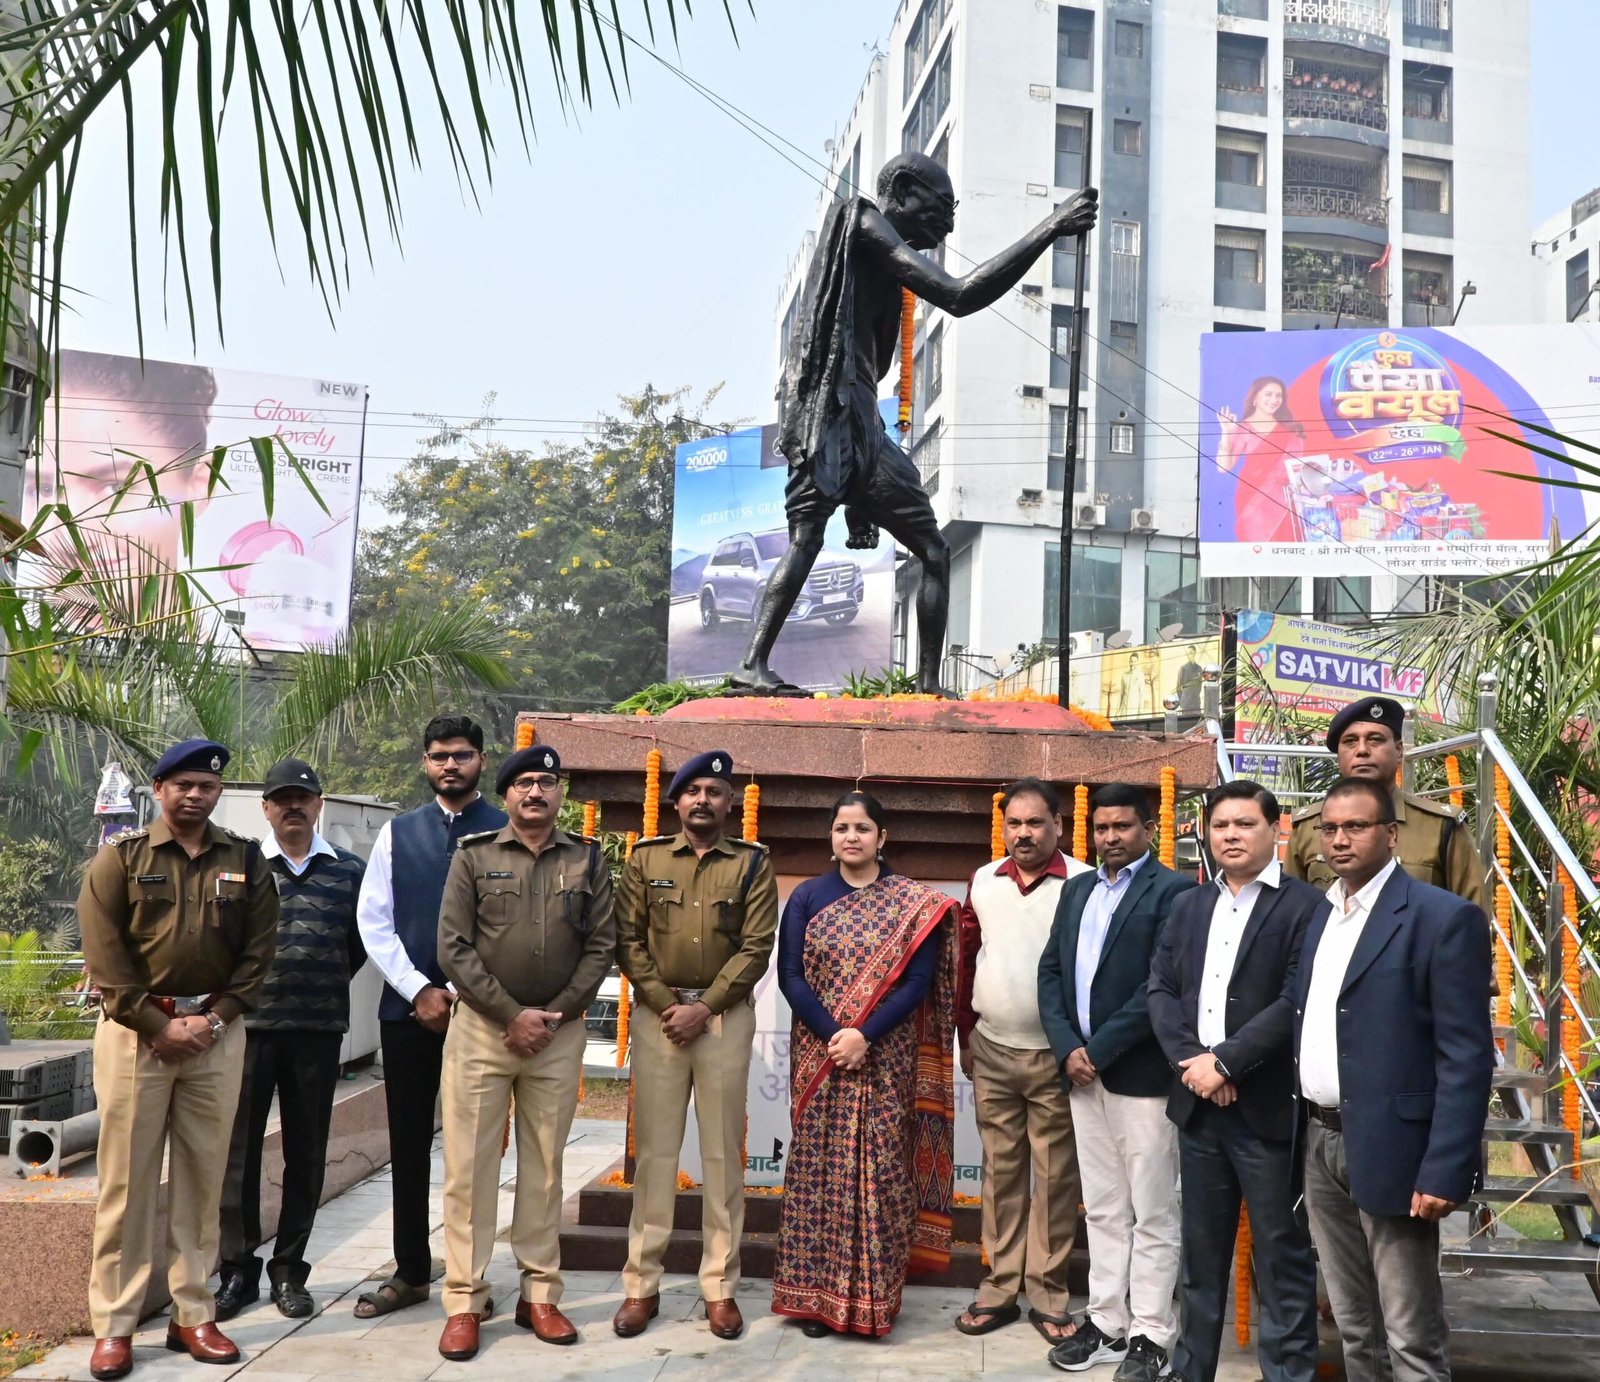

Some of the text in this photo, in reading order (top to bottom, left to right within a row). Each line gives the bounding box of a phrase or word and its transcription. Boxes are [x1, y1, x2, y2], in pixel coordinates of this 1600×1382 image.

[1374, 350, 1413, 369] फुल
[1348, 360, 1446, 391] पैसा
[320, 382, 358, 397] NEW
[254, 398, 312, 422] Glow
[1334, 390, 1462, 423] वसूल
[1389, 426, 1424, 439] सेल
[685, 450, 727, 470] 200000
[1421, 445, 1442, 455] JAN
[230, 450, 352, 474] GLSBRIGHT
[1278, 650, 1380, 689] SATVIK
[1383, 667, 1424, 694] IVF
